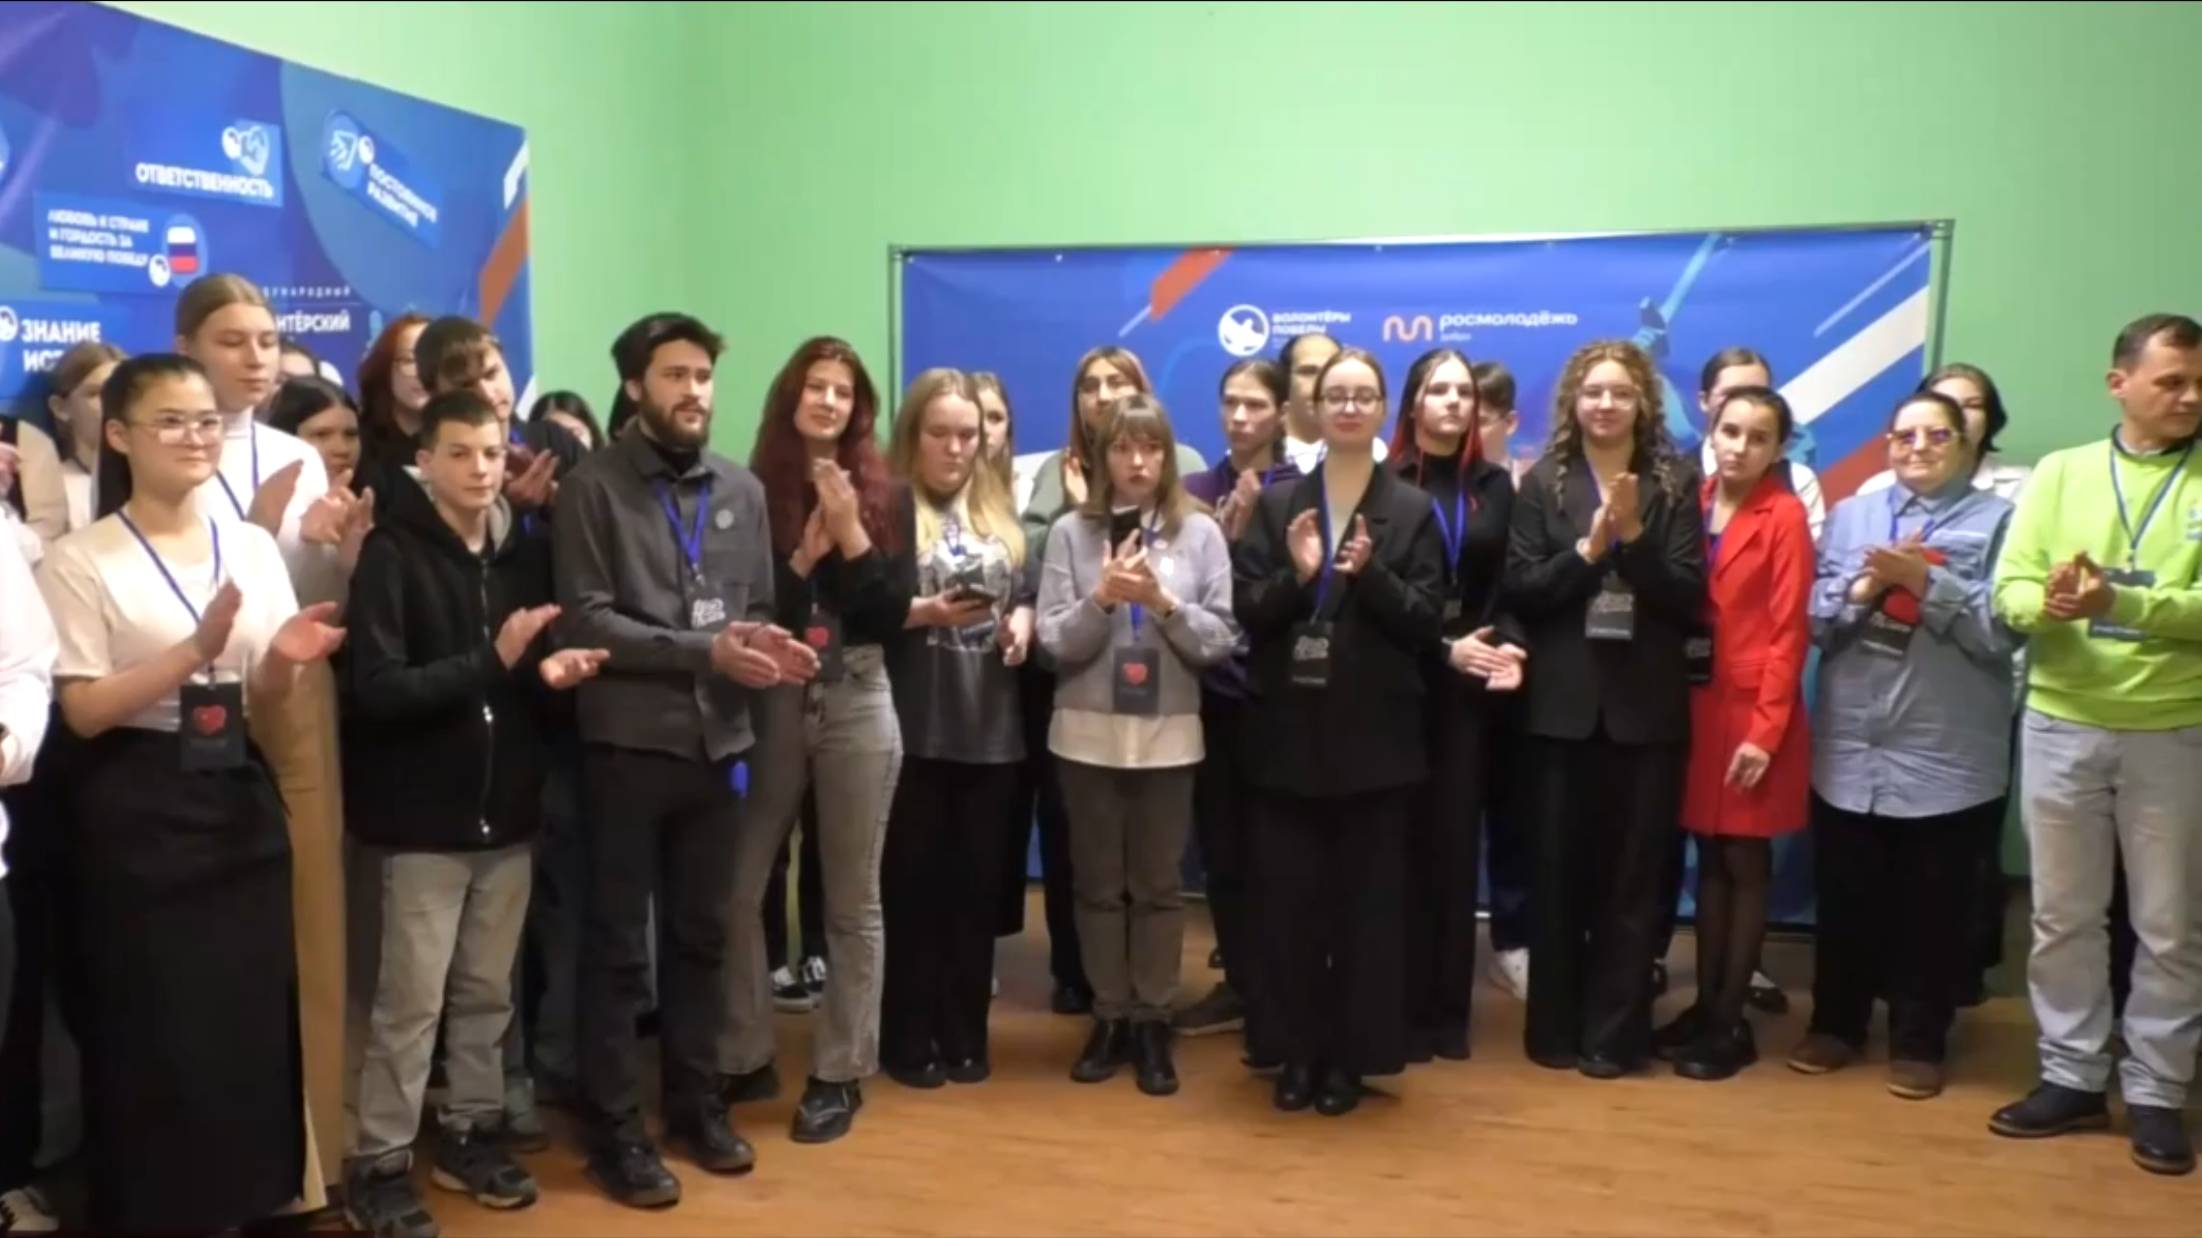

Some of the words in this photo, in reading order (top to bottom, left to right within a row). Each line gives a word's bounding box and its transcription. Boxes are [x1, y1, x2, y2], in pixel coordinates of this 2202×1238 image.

[135, 162, 274, 199] ОТВЕТСТВЕННОСТЬ
[48, 209, 97, 228] ЛЮБОВЬ
[108, 215, 149, 233] СТРАНЕ
[59, 227, 118, 247] ГОРДОСТЬ
[50, 244, 105, 263] ВЕЛИКУЮ
[276, 308, 351, 333] НТЁРСКИЙ
[1272, 310, 1351, 323] ВОЛОНТЁРЫ
[1440, 309, 1578, 331] росмолодёжь
[21, 319, 101, 343] ЗНАНИЕ
